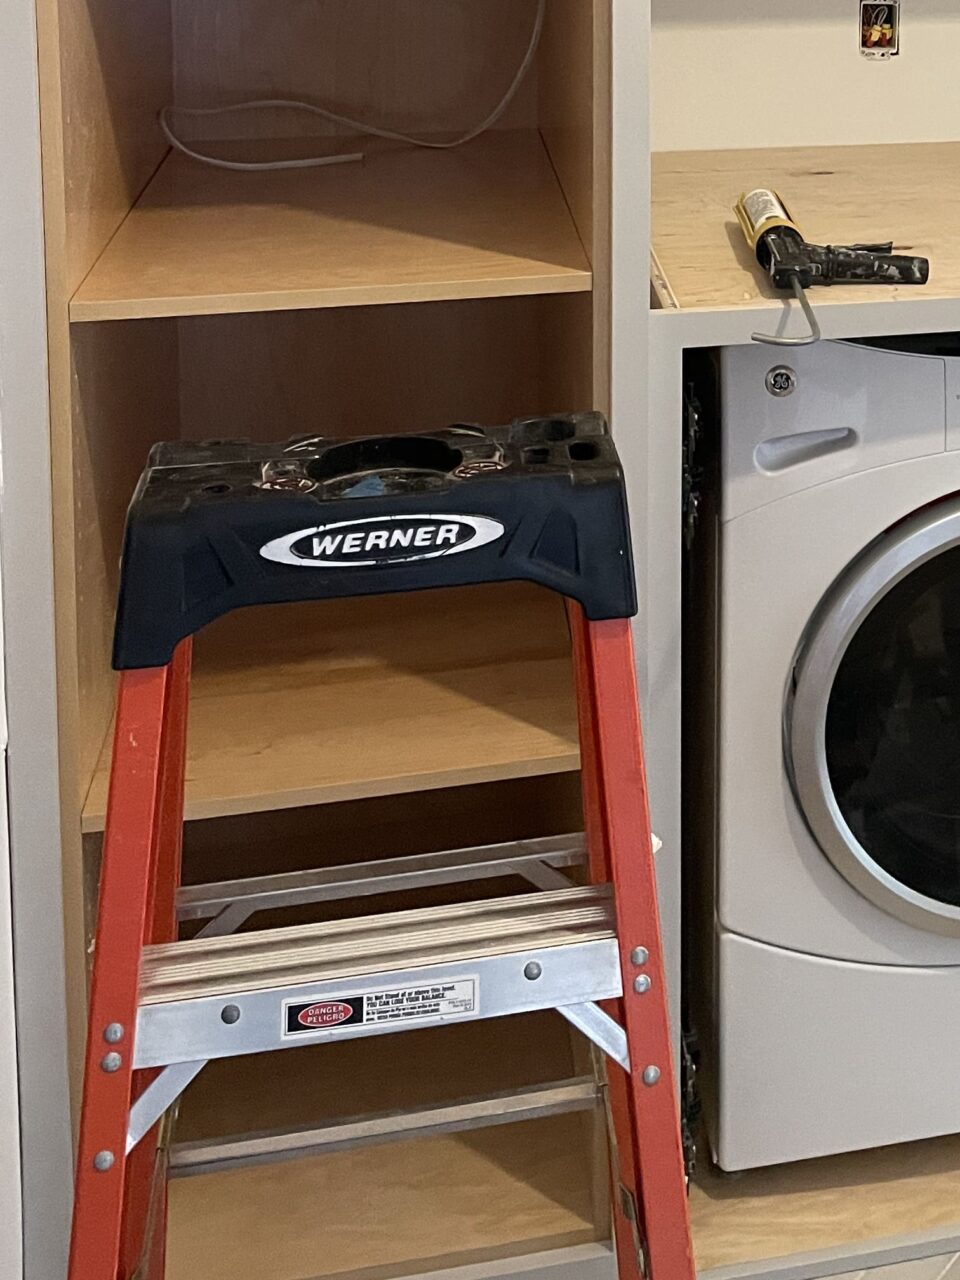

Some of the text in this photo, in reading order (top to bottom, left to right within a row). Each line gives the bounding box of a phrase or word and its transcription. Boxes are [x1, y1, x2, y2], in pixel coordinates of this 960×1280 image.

[311, 523, 460, 557] WERNER
[414, 988, 430, 996] above
[308, 1005, 344, 1016] DANGER
[307, 1012, 345, 1023] PELIGRO
